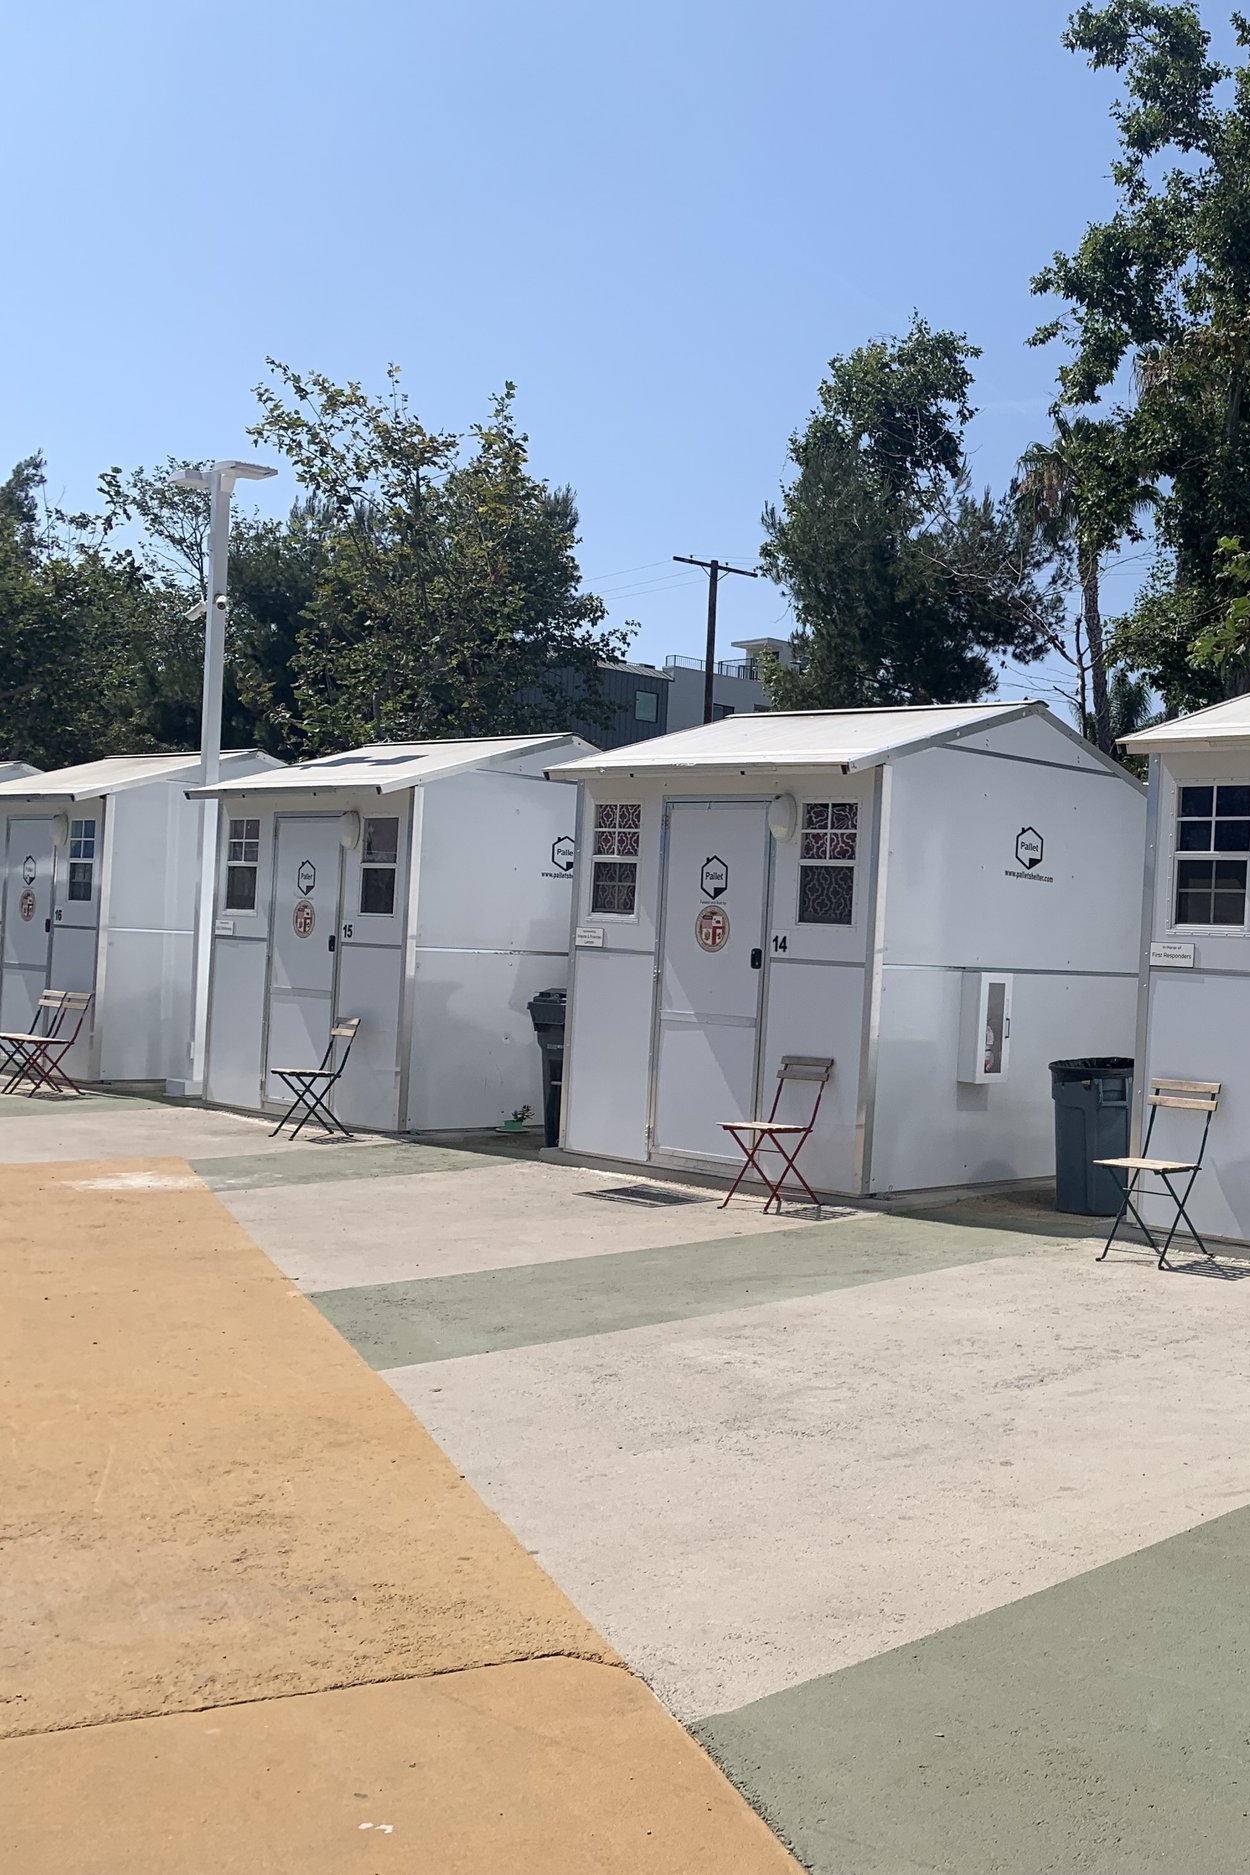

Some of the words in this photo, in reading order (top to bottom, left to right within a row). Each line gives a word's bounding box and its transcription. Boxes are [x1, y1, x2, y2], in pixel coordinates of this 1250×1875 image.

[556, 848, 574, 856] Palle
[1020, 841, 1039, 852] Pallet
[541, 871, 574, 879] www.palletsh
[705, 872, 724, 880] Pallet
[55, 909, 63, 921] 16
[342, 924, 353, 938] 15
[772, 935, 788, 952] 14
